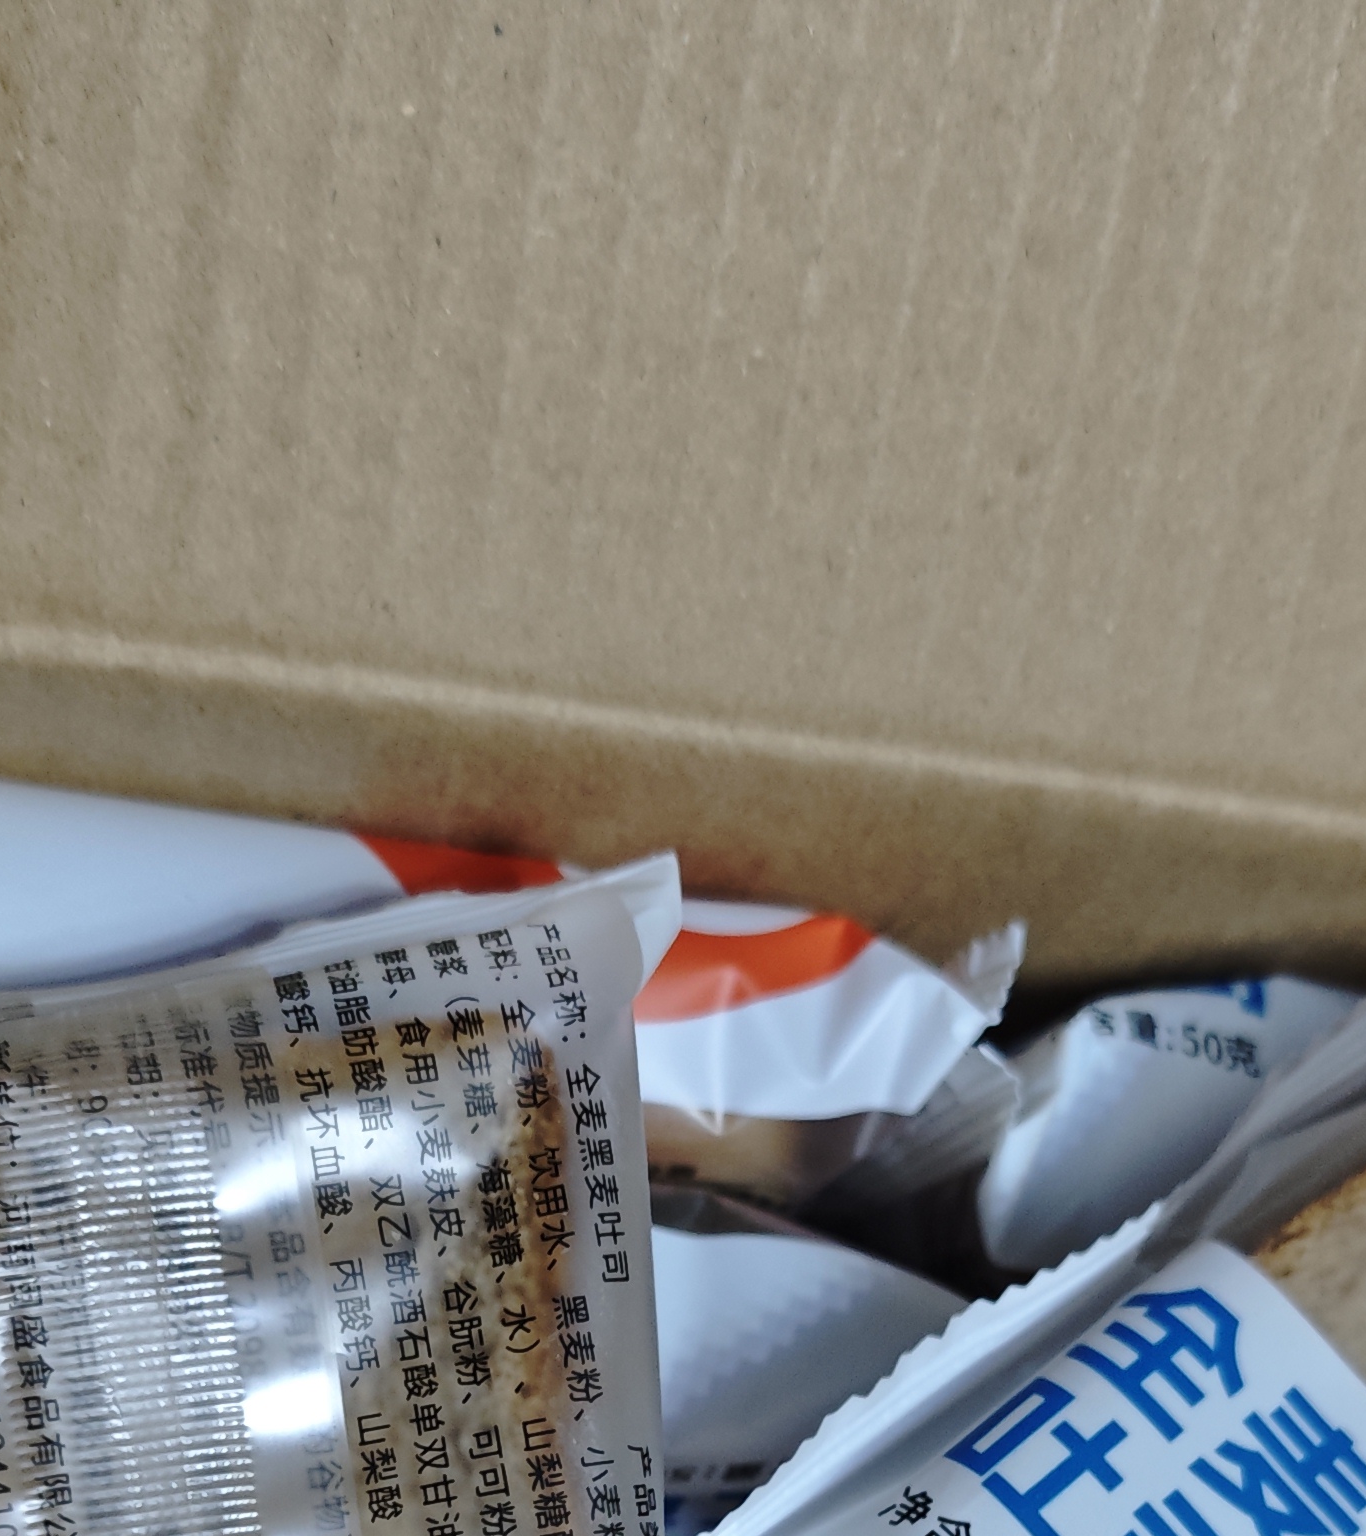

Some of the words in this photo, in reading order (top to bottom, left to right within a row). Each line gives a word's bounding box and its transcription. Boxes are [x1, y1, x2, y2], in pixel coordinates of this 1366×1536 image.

[527, 922, 629, 1285] 产品名称：全麦黑麦吐司
